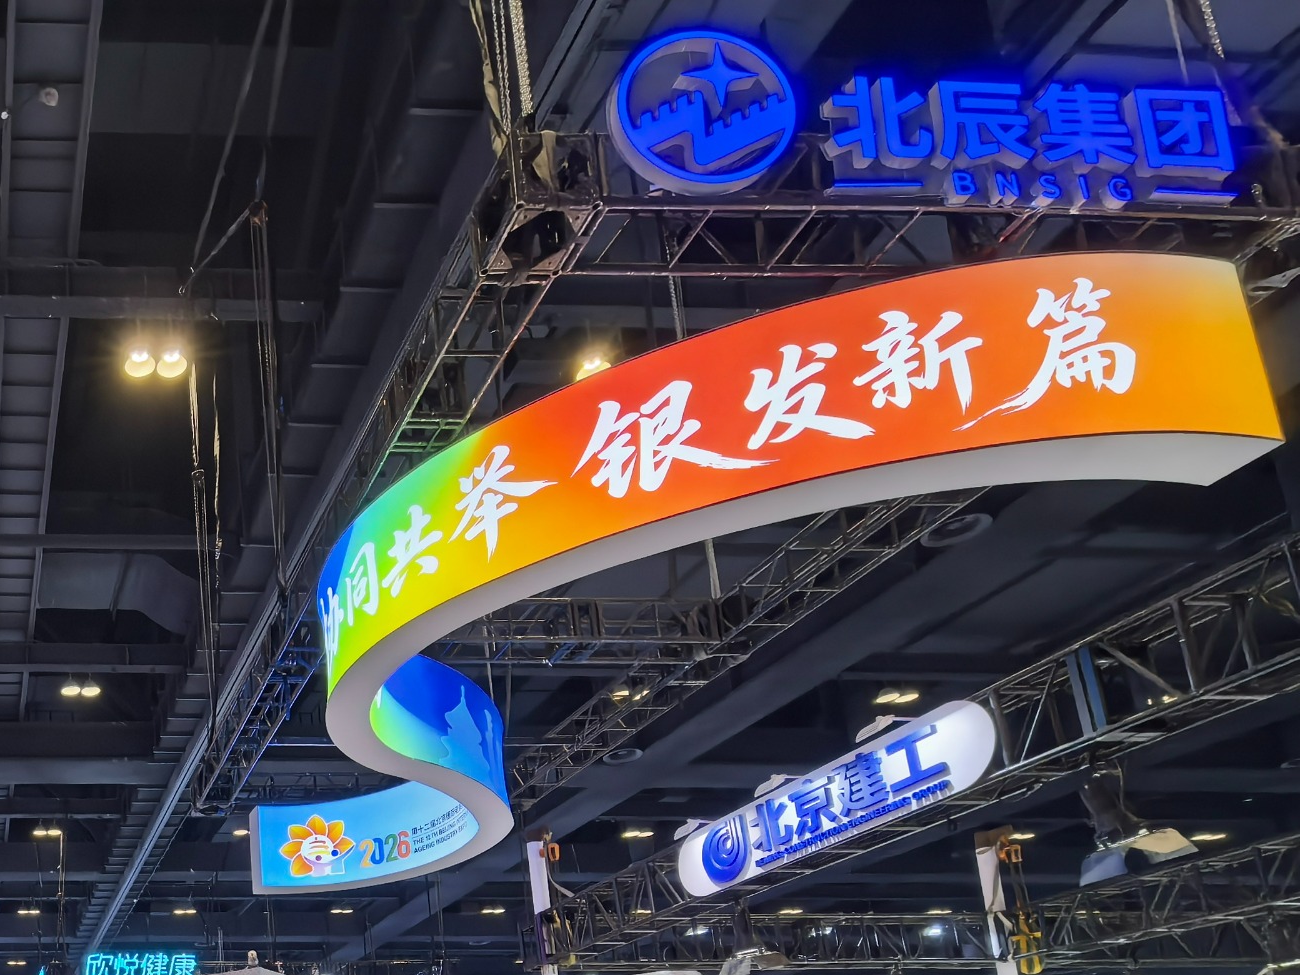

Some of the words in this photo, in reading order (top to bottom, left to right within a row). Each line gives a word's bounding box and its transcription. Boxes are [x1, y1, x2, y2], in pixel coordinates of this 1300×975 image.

[831, 74, 1236, 173] 北辰集团
[955, 170, 1134, 201] BNSIG
[752, 724, 950, 852] 北京建工
[359, 830, 411, 868] 2026
